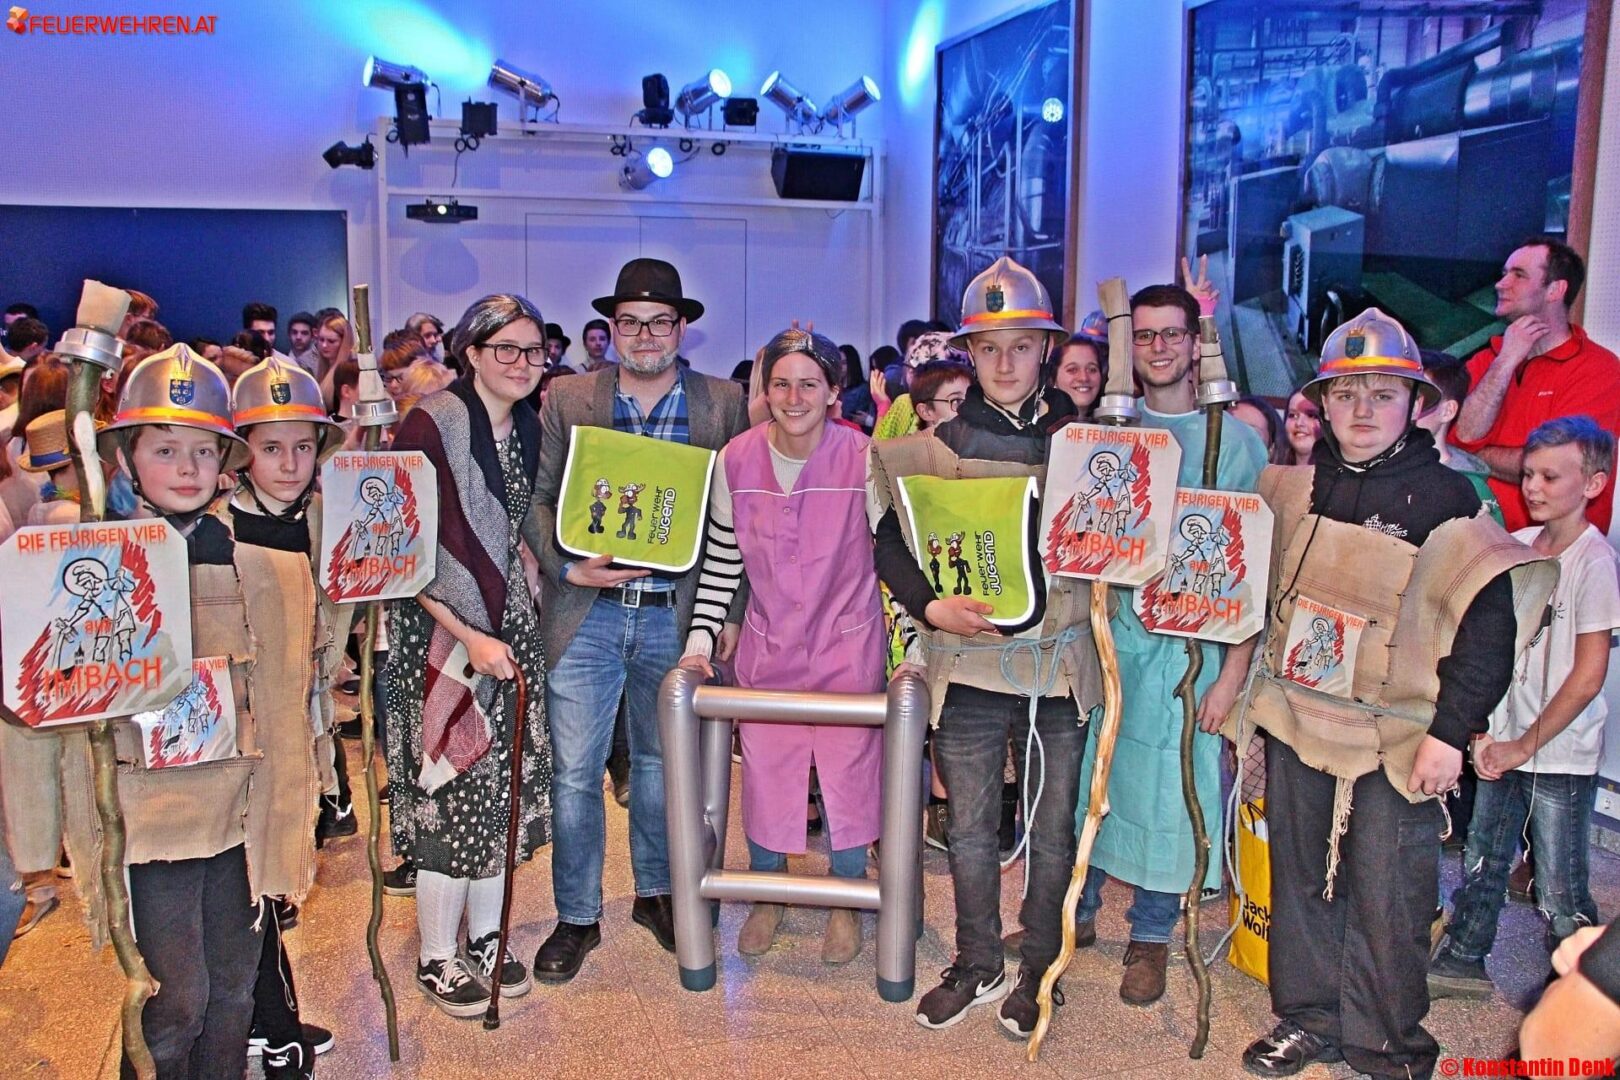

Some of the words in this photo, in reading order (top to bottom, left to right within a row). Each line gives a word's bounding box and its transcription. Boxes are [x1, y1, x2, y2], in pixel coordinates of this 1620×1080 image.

[1066, 427, 1085, 441] DIE
[1087, 430, 1141, 445] FEURIGEN
[1144, 433, 1168, 447] VIER
[334, 455, 349, 468] DIE
[352, 456, 399, 467] FEURIGEN
[402, 456, 423, 467] VIER
[1234, 497, 1259, 512] VIER
[17, 533, 45, 551] DIE
[50, 527, 129, 548] FEURIGEN
[133, 524, 167, 542] VIER
[1063, 531, 1147, 564] IMBACH
[345, 554, 417, 580] IMBACH
[1160, 591, 1241, 623] IMBACH
[43, 656, 163, 694] IMBACH
[1243, 894, 1271, 922] Jack
